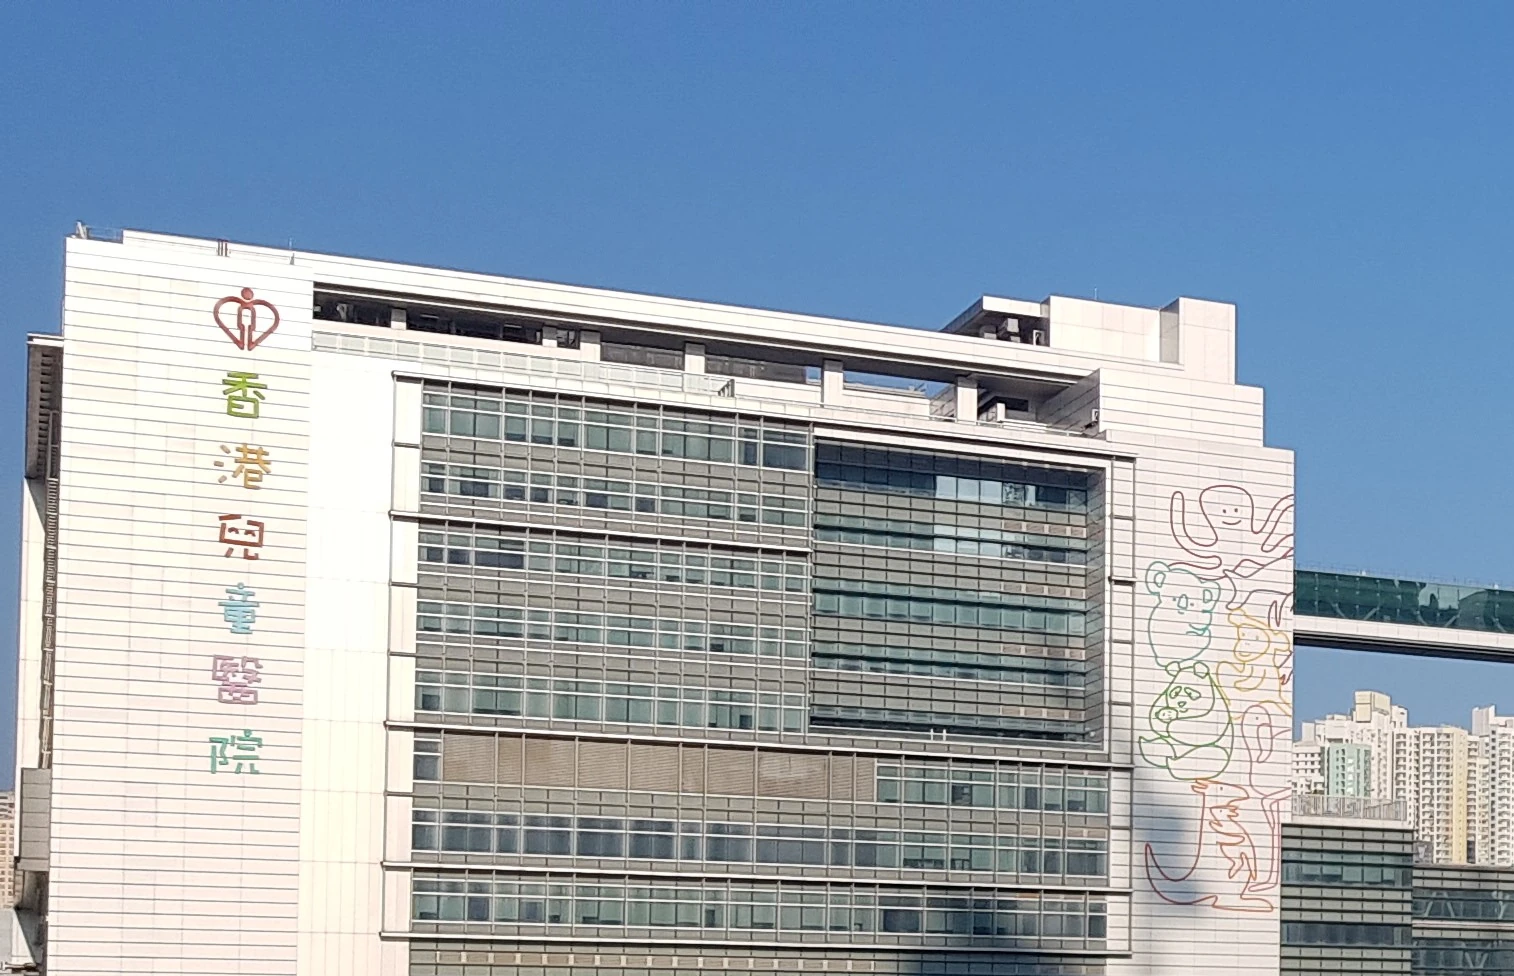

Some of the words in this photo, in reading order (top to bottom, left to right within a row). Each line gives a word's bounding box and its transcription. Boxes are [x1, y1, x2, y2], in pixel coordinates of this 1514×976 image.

[209, 371, 272, 775] 香港兒童醫院
